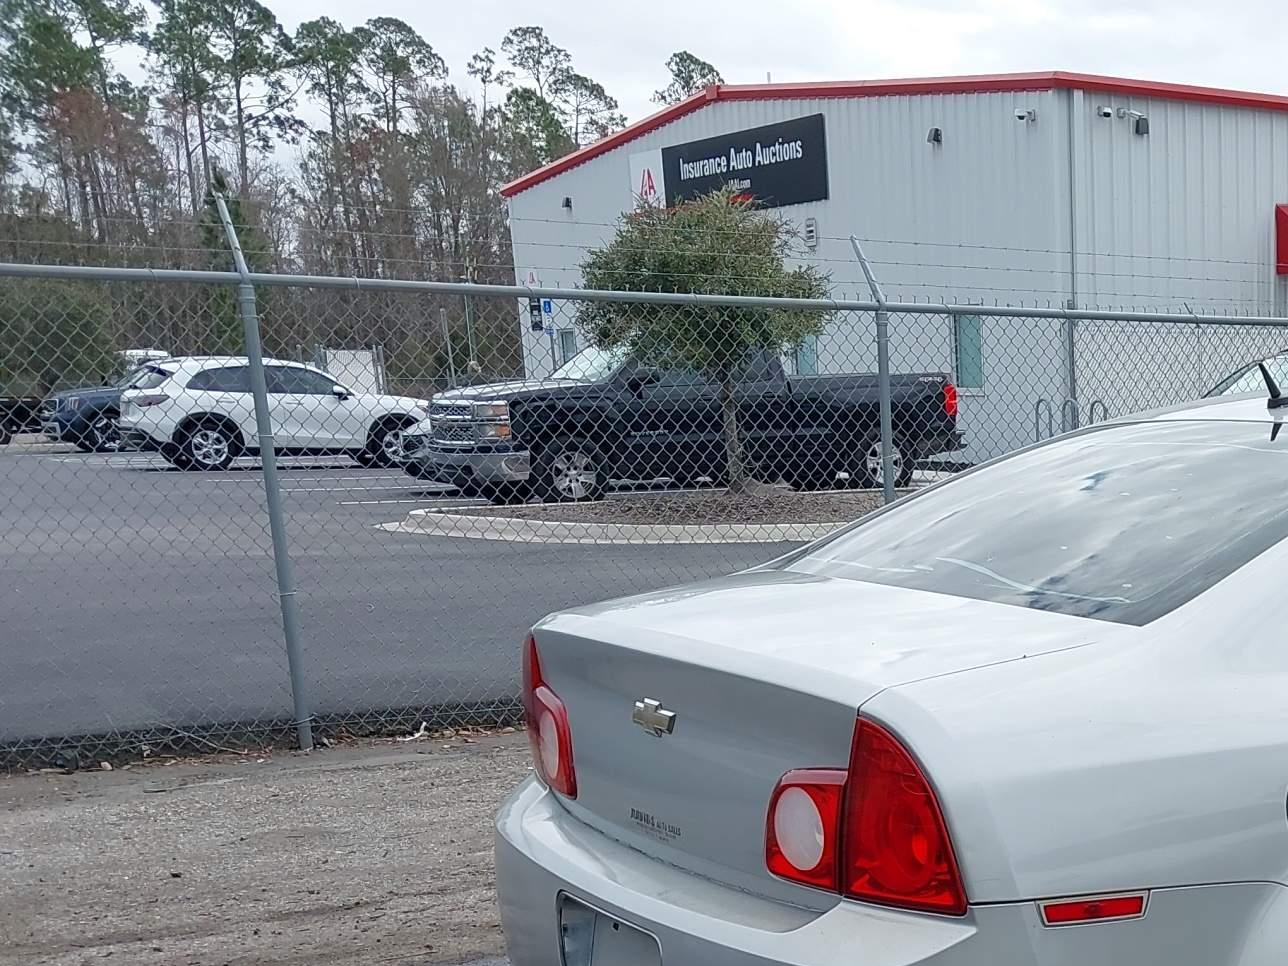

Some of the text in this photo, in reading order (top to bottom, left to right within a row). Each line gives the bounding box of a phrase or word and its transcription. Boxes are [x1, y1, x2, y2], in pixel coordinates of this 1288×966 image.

[680, 138, 802, 180] Insurance Auto Auctions
